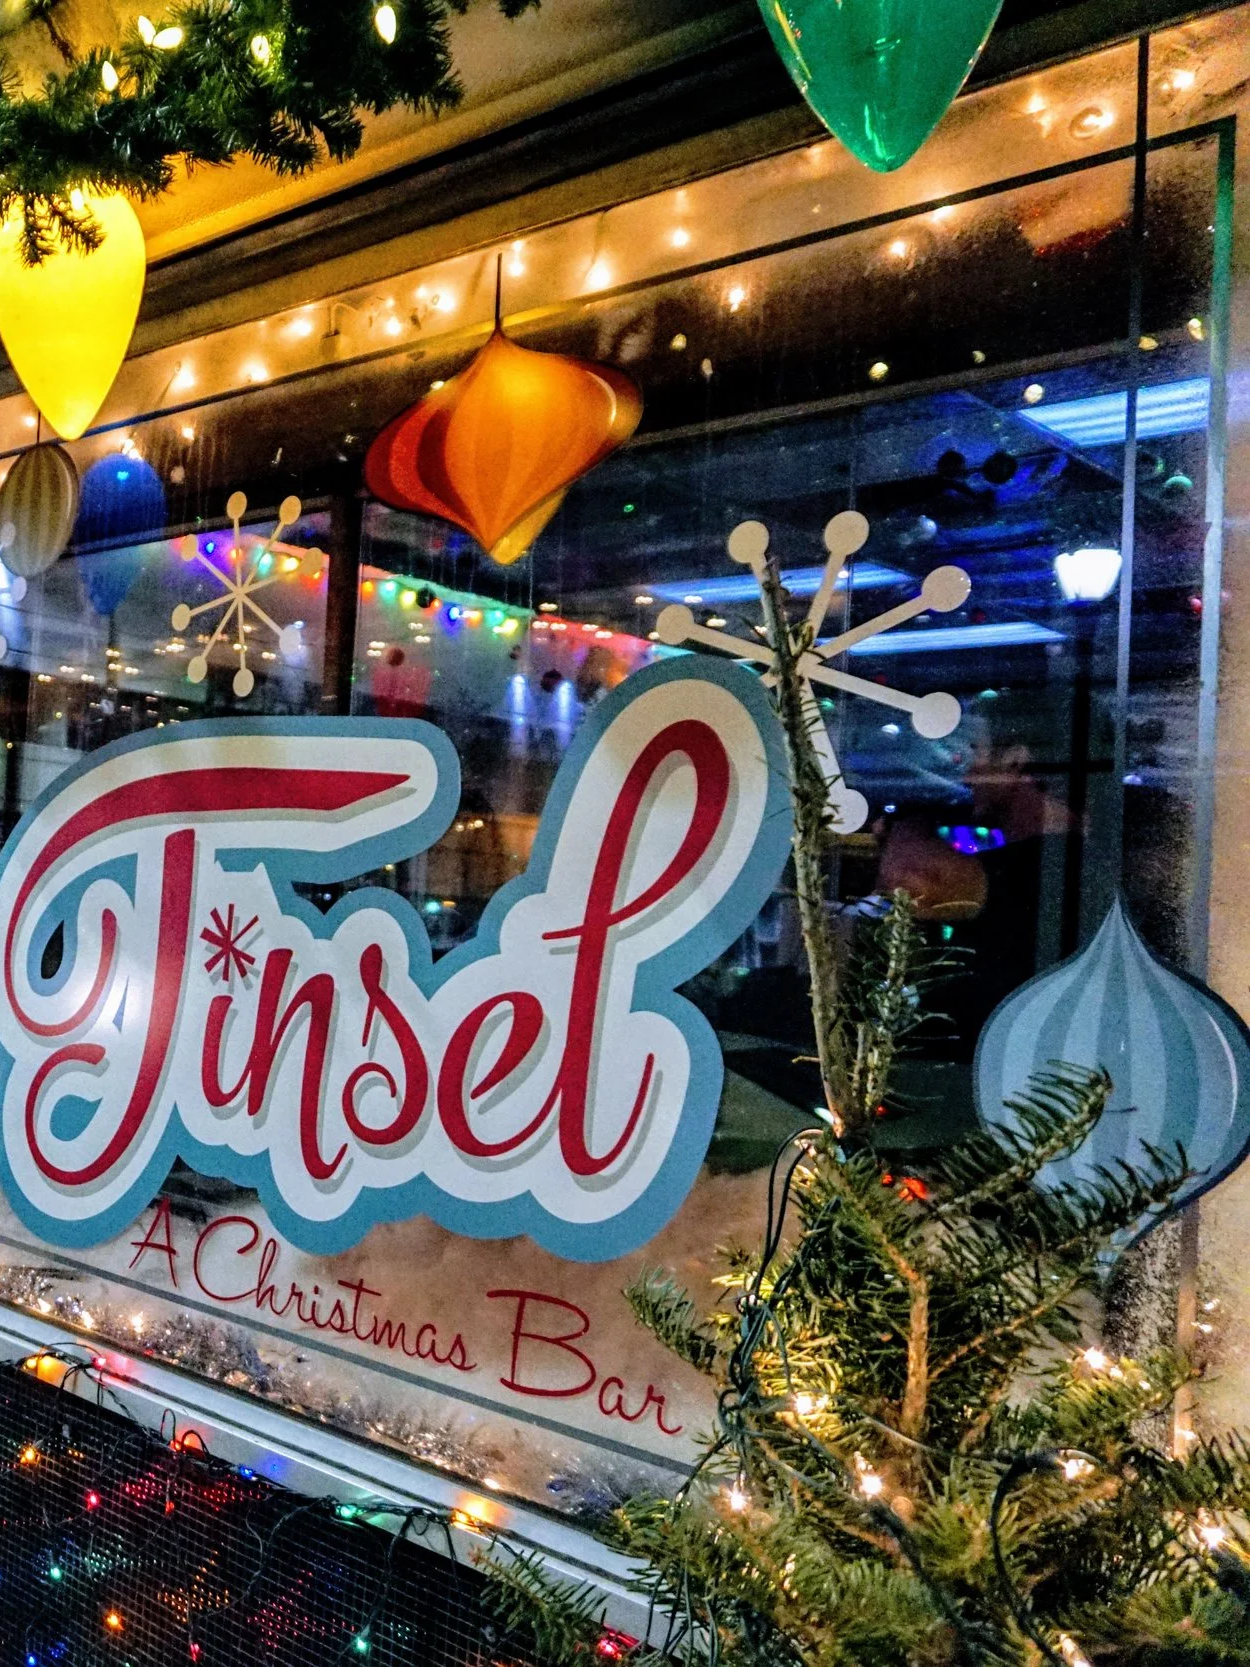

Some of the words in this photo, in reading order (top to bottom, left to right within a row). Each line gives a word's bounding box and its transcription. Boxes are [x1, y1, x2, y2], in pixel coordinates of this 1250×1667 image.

[4, 718, 731, 1188] Tinsel
[128, 1199, 181, 1289] A
[192, 1214, 478, 1371] Christmas
[486, 1288, 683, 1435] Bar
